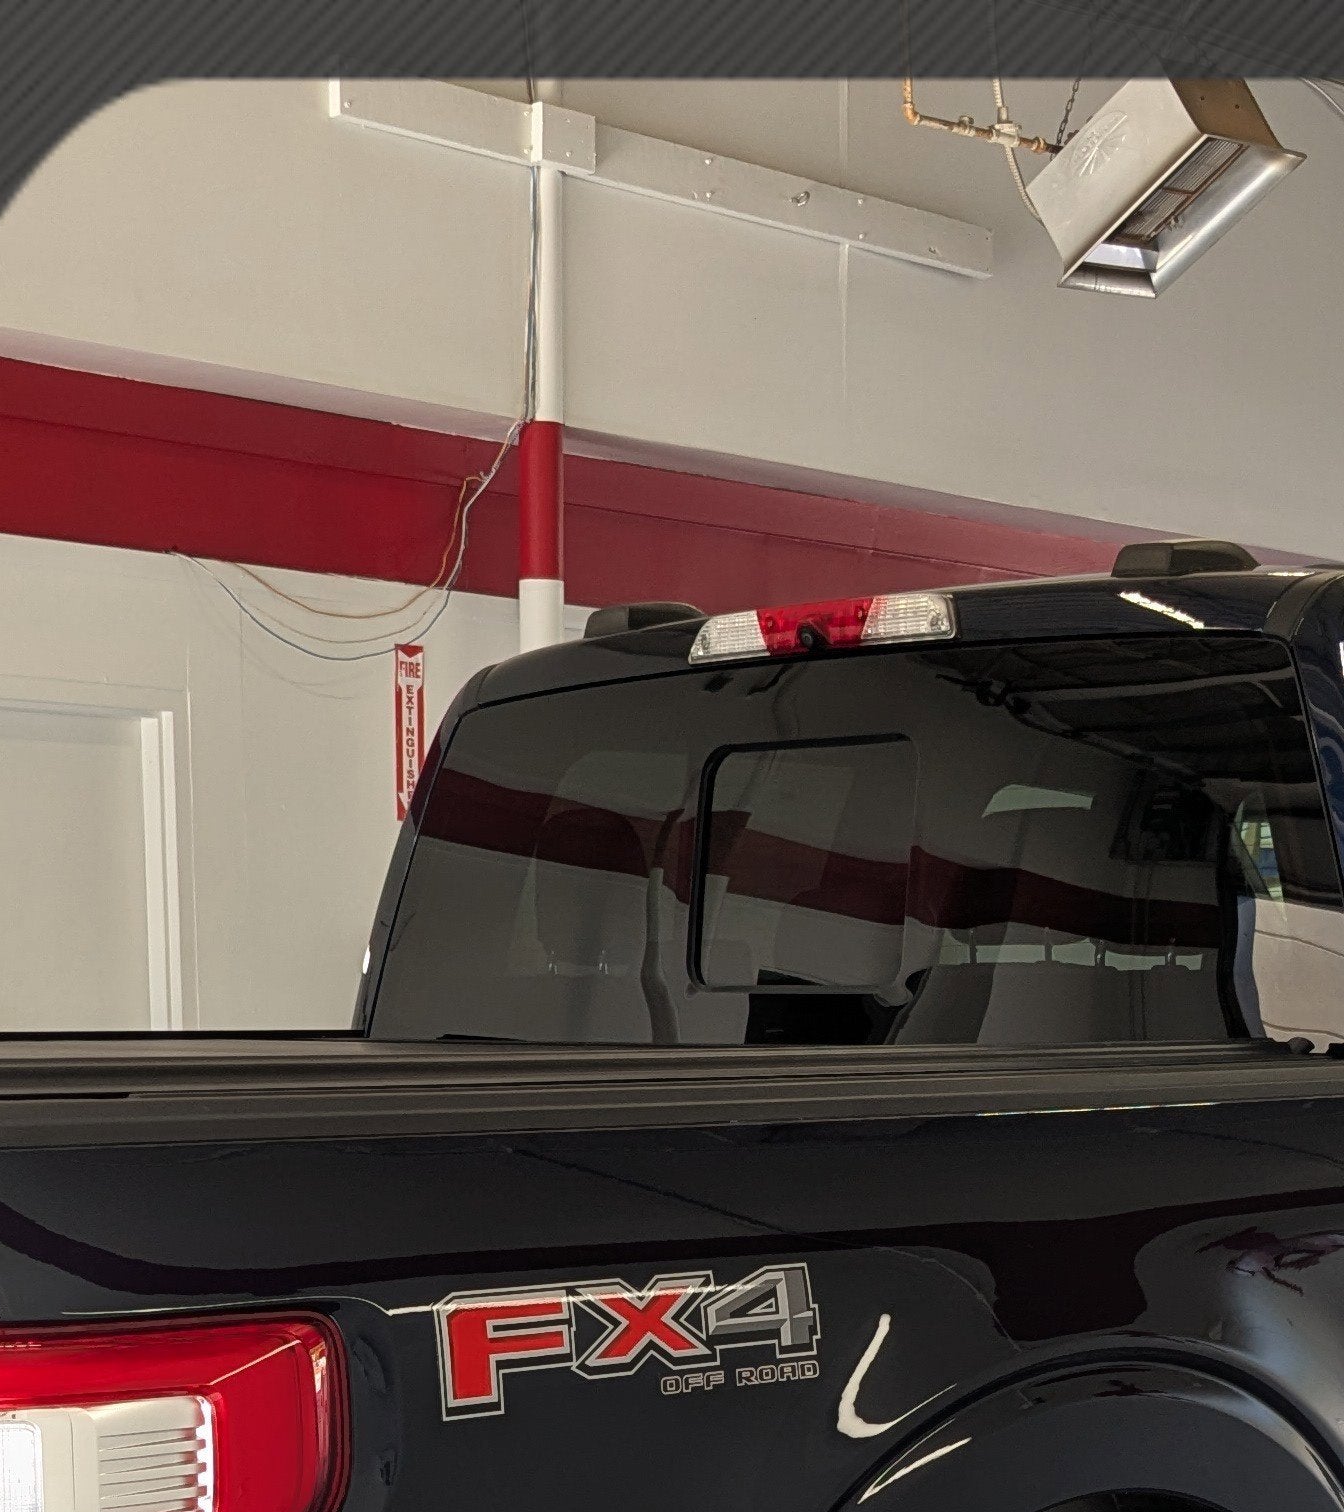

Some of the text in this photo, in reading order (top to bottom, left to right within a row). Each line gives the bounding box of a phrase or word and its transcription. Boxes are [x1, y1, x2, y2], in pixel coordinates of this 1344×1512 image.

[399, 660, 421, 679] FIRE
[405, 684, 416, 806] EXTINGUISHE
[433, 1261, 821, 1422] FX4
[660, 1359, 820, 1396] OFF ROAD
